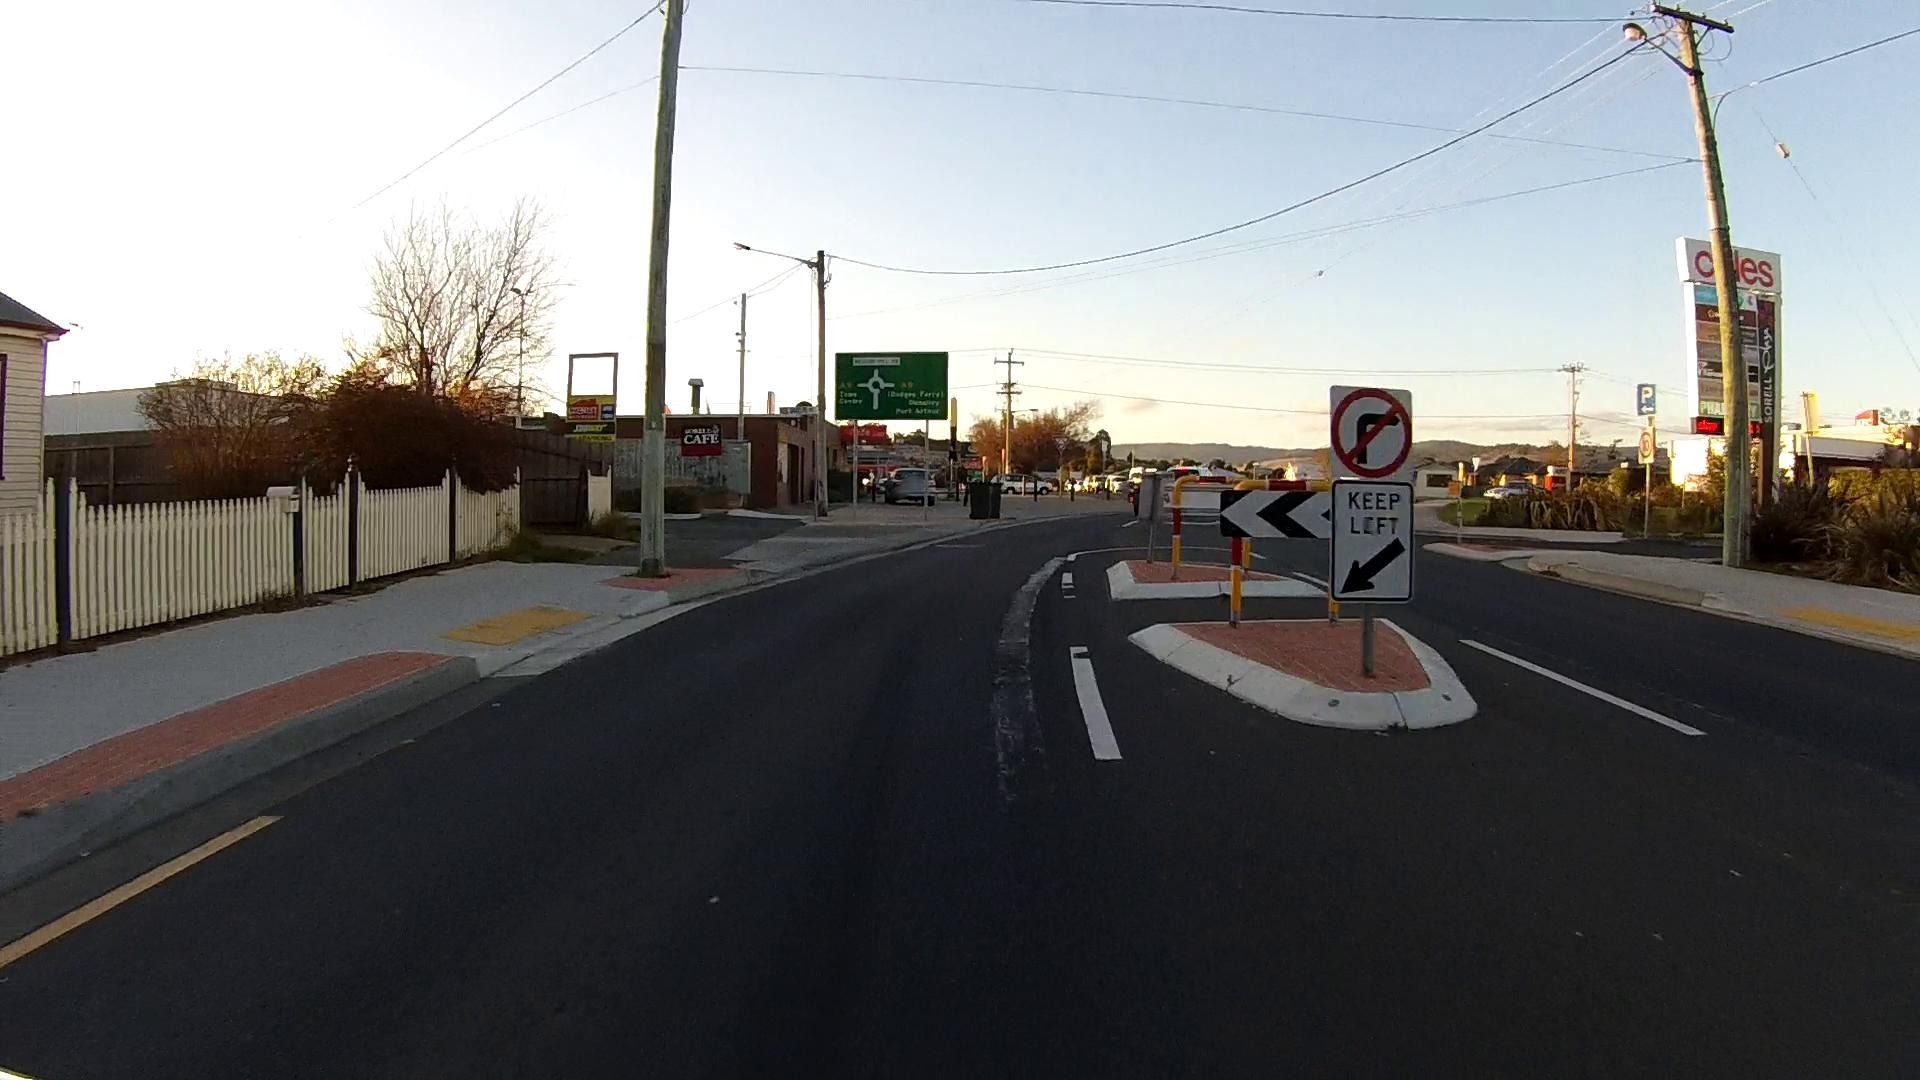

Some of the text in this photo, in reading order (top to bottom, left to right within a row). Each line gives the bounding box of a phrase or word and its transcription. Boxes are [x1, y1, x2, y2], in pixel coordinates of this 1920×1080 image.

[1694, 250, 1774, 288] cles
[1641, 386, 1653, 403] P
[1763, 376, 1774, 424] SORELL
[1348, 492, 1400, 509] KEEP
[1350, 517, 1398, 534] LEFT
